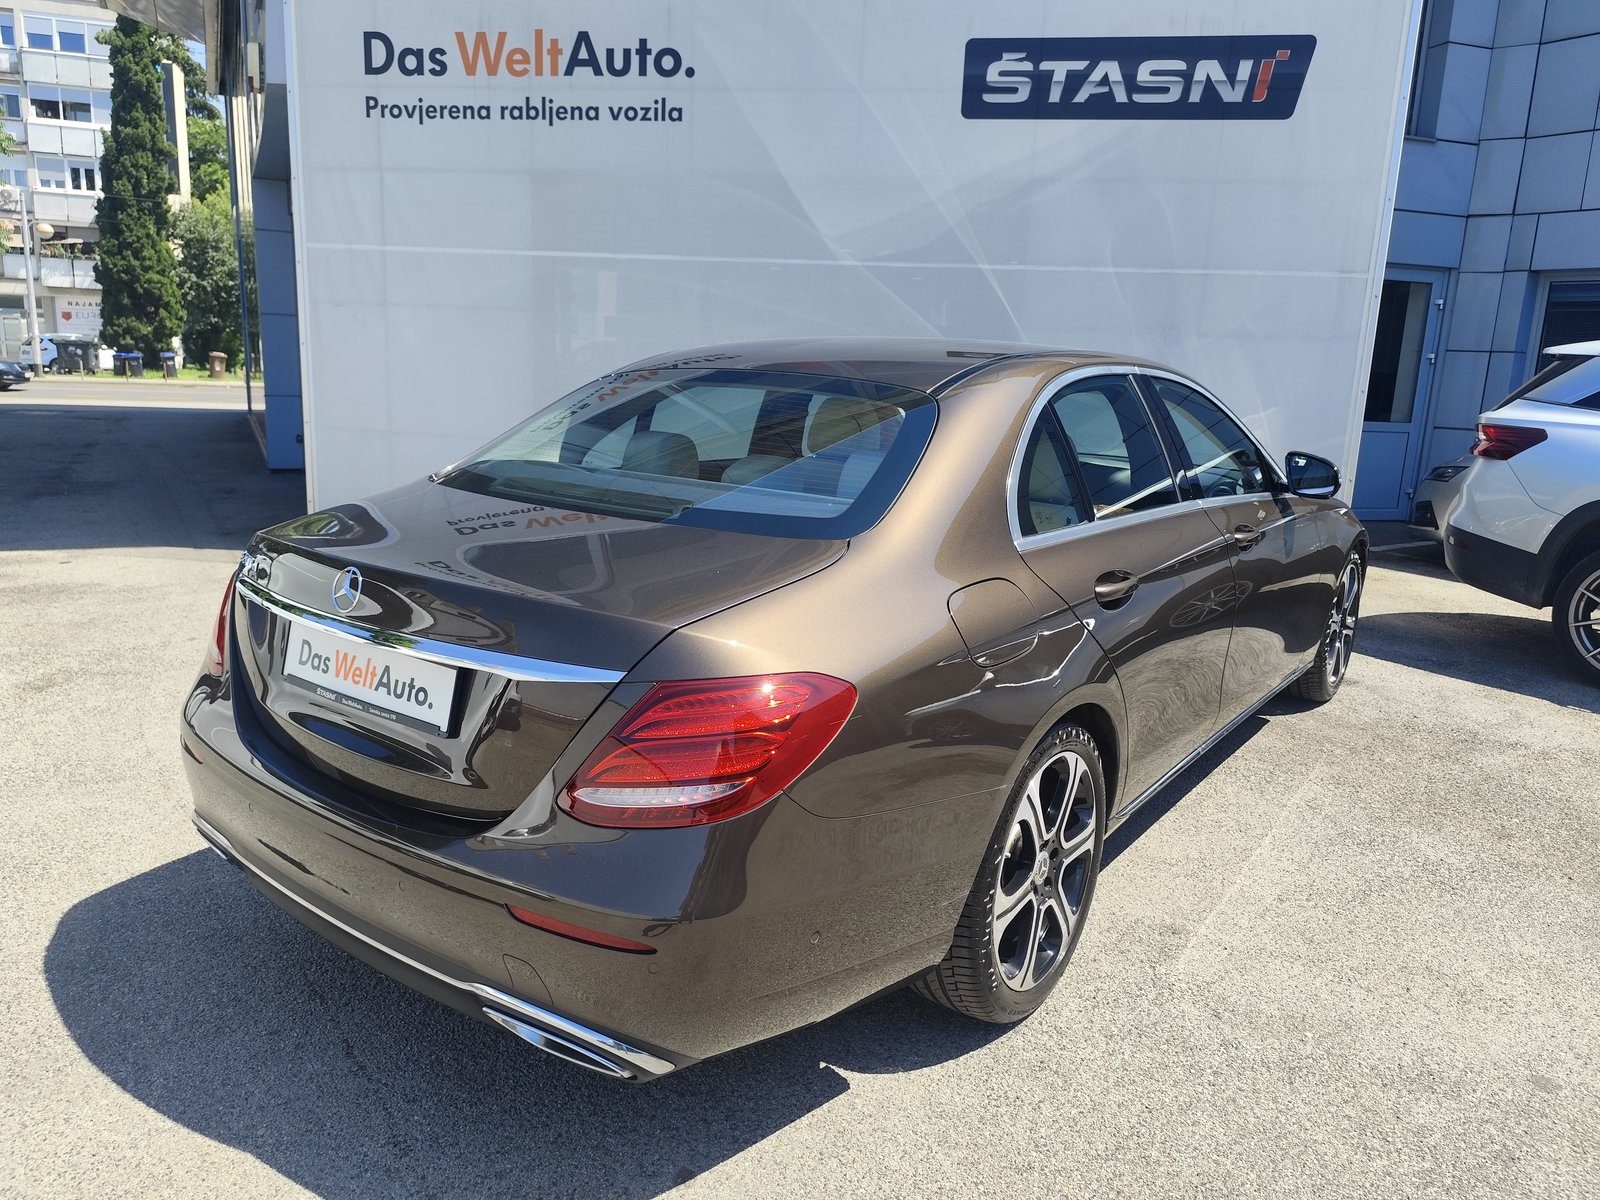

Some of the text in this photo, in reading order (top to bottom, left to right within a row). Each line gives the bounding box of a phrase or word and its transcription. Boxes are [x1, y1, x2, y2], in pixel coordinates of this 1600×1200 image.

[363, 29, 695, 78] Das WeltAuto.
[365, 96, 683, 126] Provjerena rabljena vozila
[298, 638, 433, 709] Das WeltAuto.
